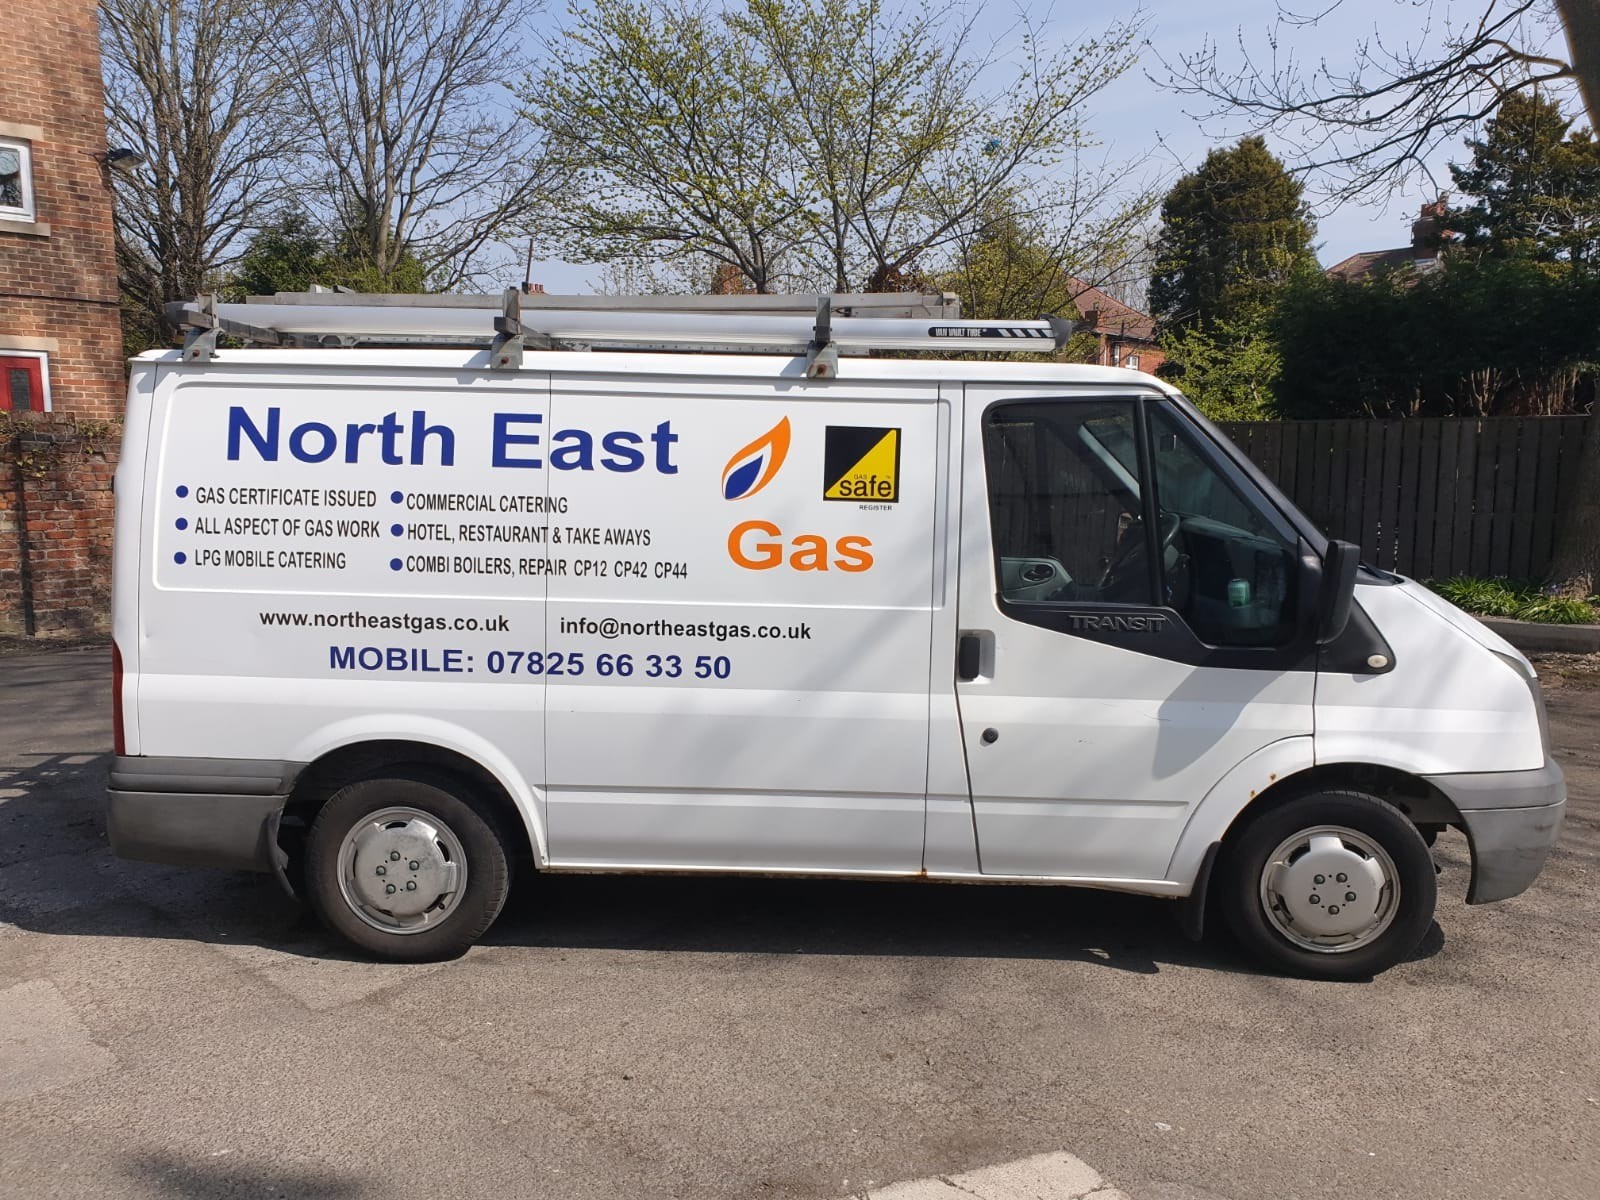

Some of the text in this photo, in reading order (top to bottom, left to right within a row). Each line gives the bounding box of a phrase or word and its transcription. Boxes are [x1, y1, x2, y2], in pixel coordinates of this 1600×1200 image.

[935, 327, 947, 337] VAN
[226, 406, 679, 474] North East
[196, 486, 377, 508] GAS CERTIFICATE ISSUED
[839, 474, 891, 497] safe
[406, 493, 568, 514] COMMERCIAL CATERING
[194, 516, 380, 538] ALL ASPECT OF GAS WORK
[407, 523, 651, 547] HOTEL, RESTAURANT & TAKE AWAYS
[728, 519, 874, 573] Gas
[195, 549, 346, 570] LPG MOBILE CATERING
[406, 555, 688, 579] COMBI BOILERS, REPAIR CP12 CP42 CP44
[259, 611, 510, 634] www.northeastgas.co.uk
[560, 617, 812, 641] info@northeastgas.co.uk
[1069, 614, 1166, 632] TRANSIT
[329, 645, 731, 679] MOBILE: 07825 66 33 50
